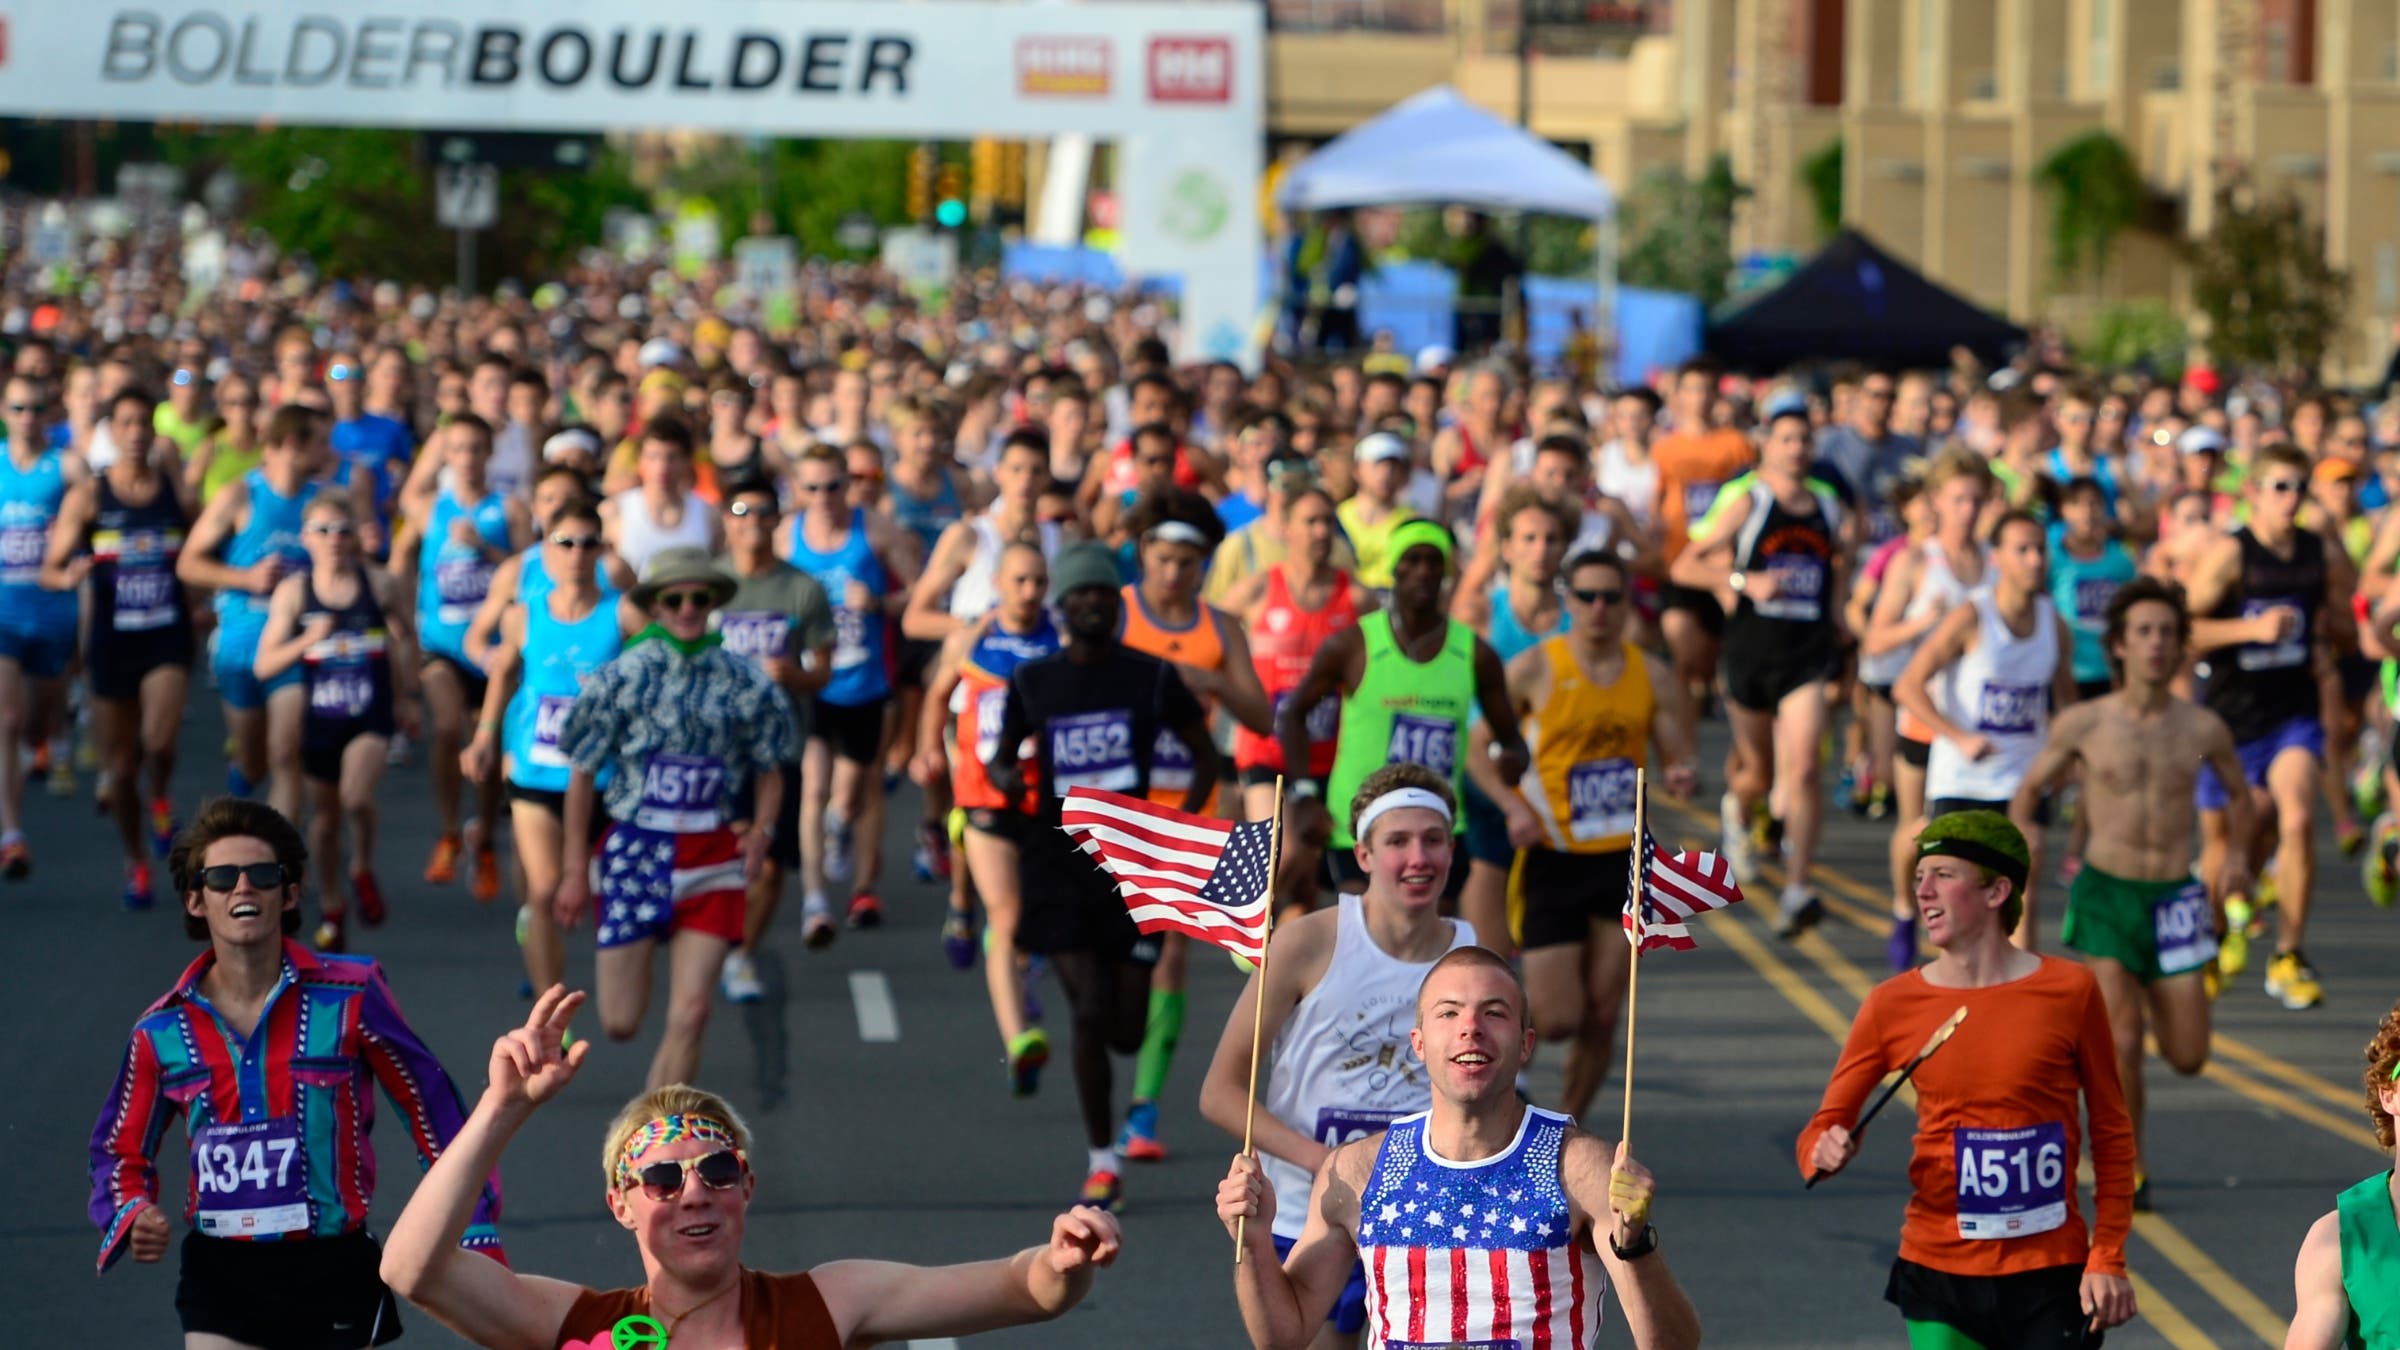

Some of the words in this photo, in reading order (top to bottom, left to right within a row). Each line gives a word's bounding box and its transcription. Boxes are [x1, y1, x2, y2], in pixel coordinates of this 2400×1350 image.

[103, 11, 917, 92] BOLDERBOULDER
[1053, 726, 1132, 767] A552
[642, 763, 722, 803] A517
[198, 1138, 296, 1194] A347
[1959, 1142, 2062, 1198] A516
